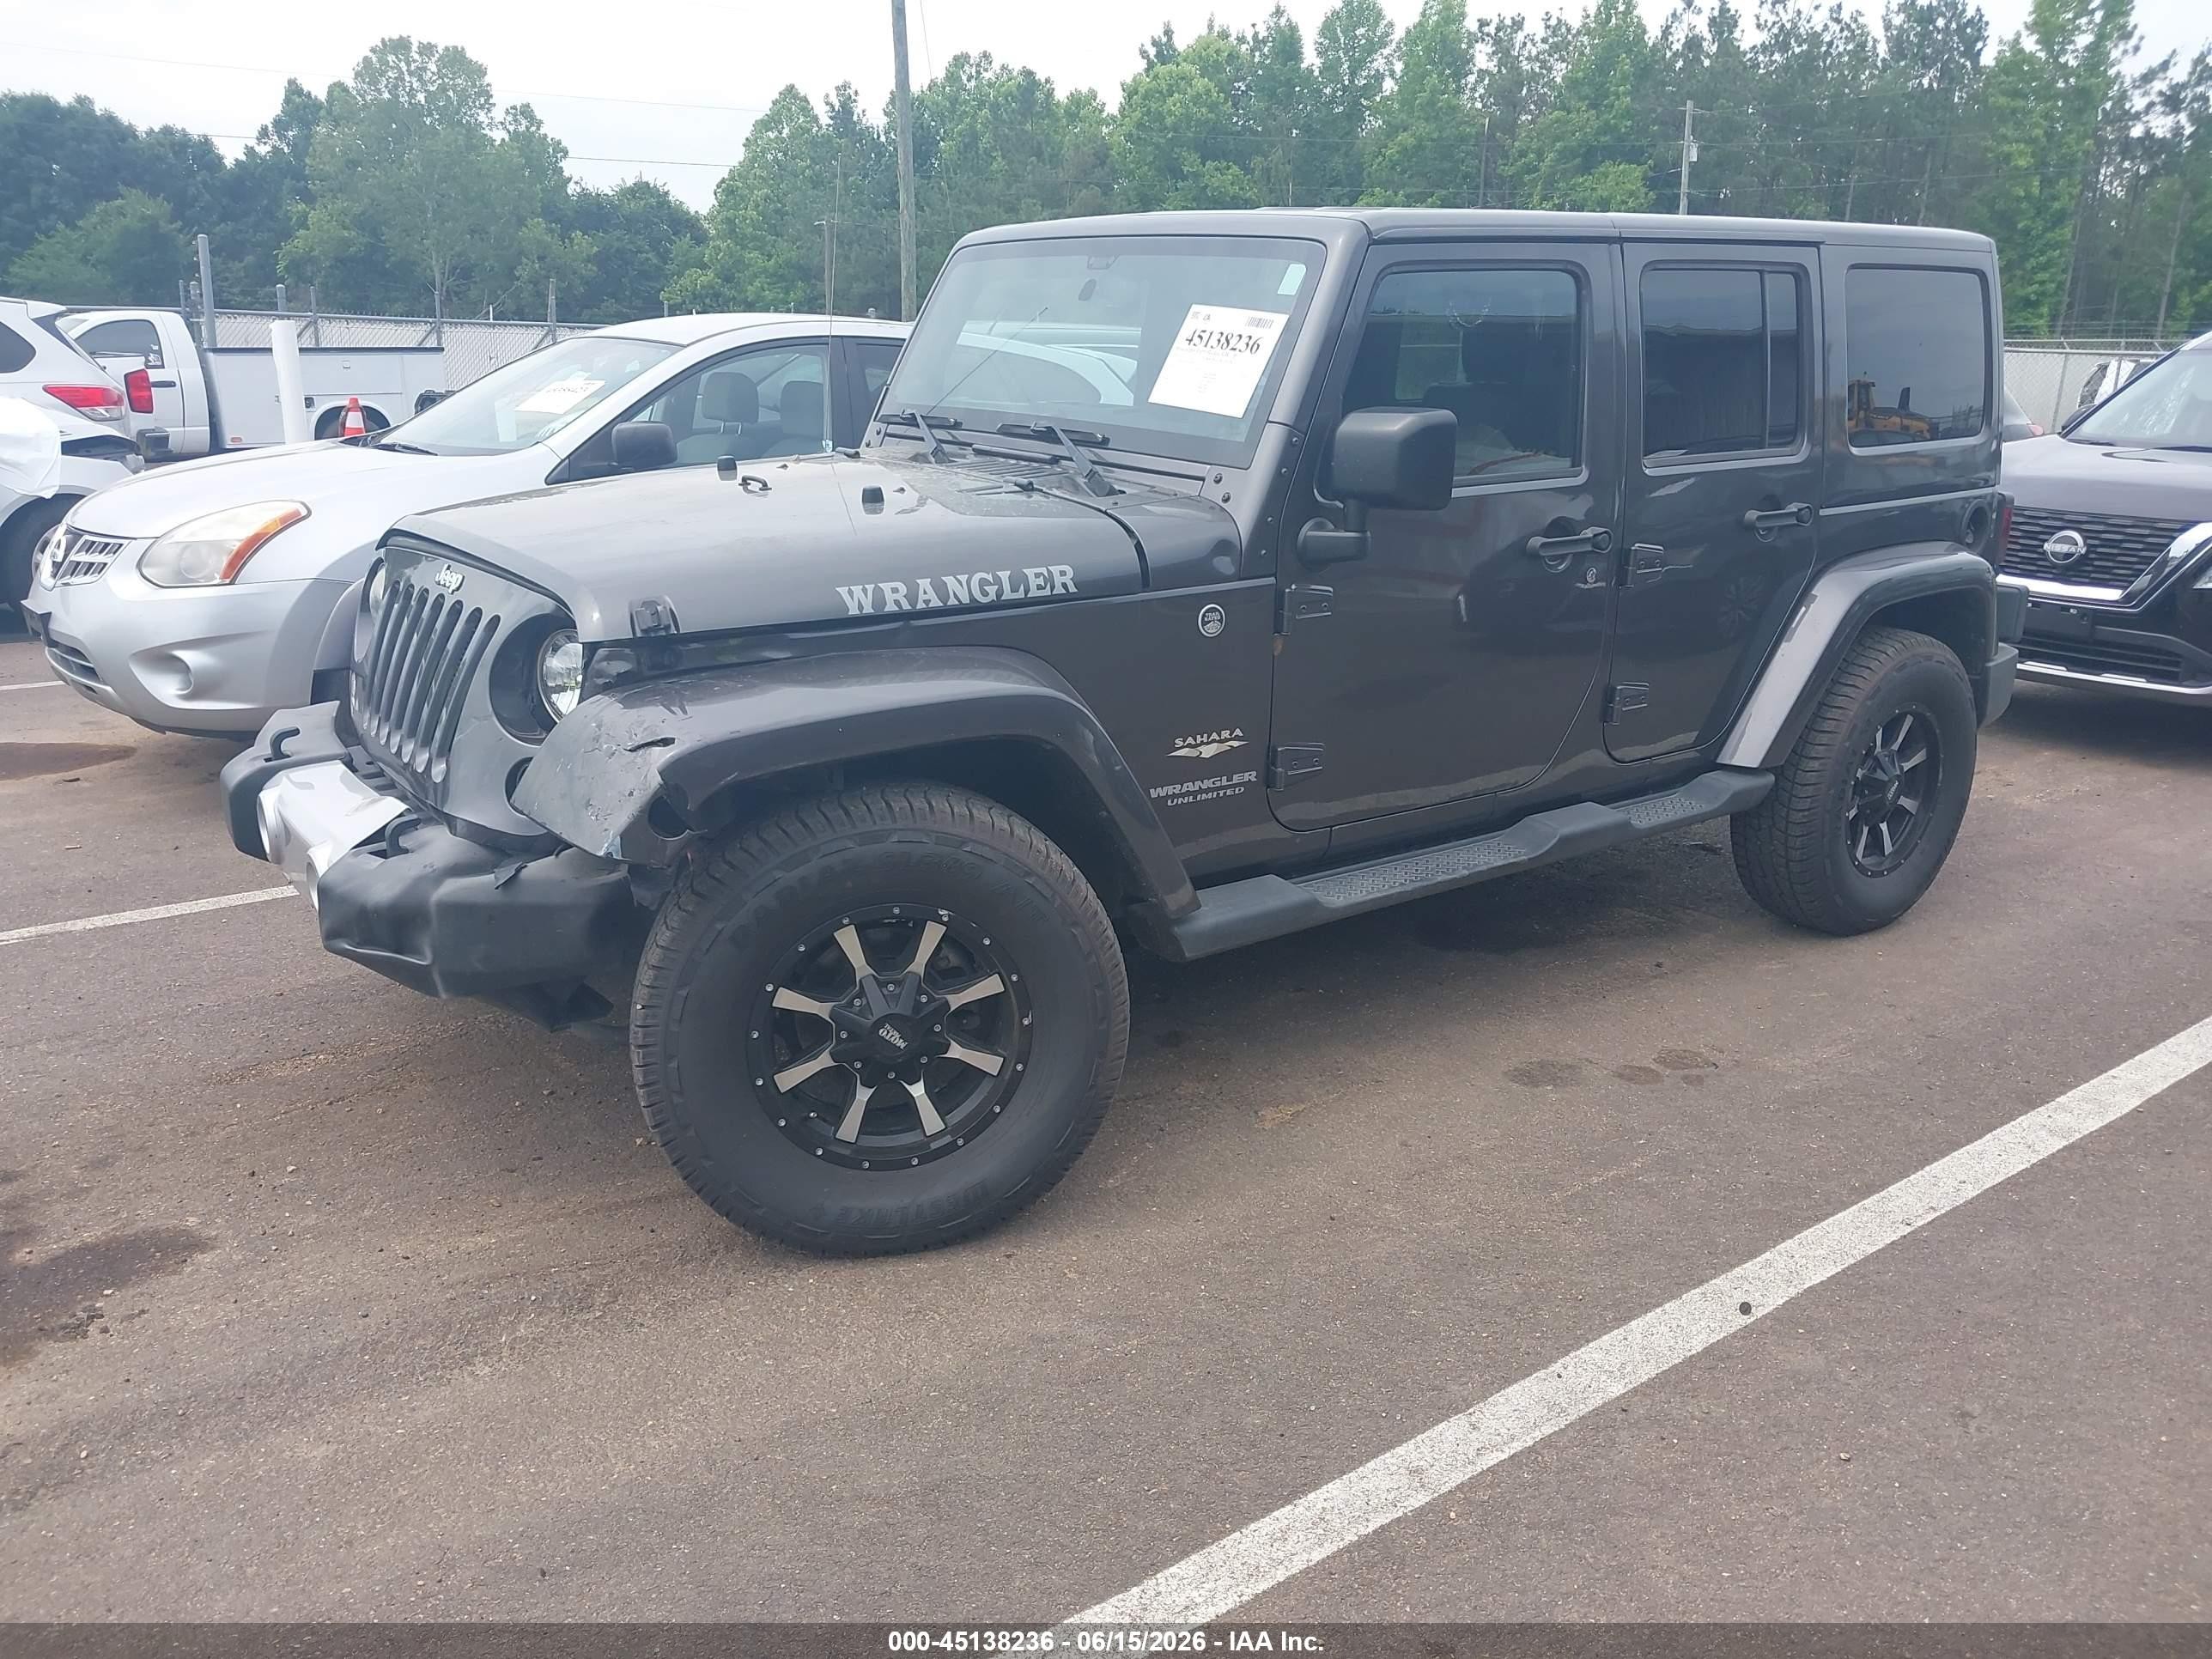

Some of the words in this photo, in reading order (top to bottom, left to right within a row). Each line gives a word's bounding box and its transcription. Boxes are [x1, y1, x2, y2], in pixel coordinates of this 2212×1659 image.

[1185, 329, 1263, 355] 45138236
[435, 563, 464, 593] Jeep
[835, 564, 1079, 615] WRANGLER
[1174, 727, 1243, 748] SAHARA
[1149, 770, 1257, 799] WRANGLER
[1167, 787, 1244, 806] UNLIMITED
[878, 1028, 908, 1049] MOTO
